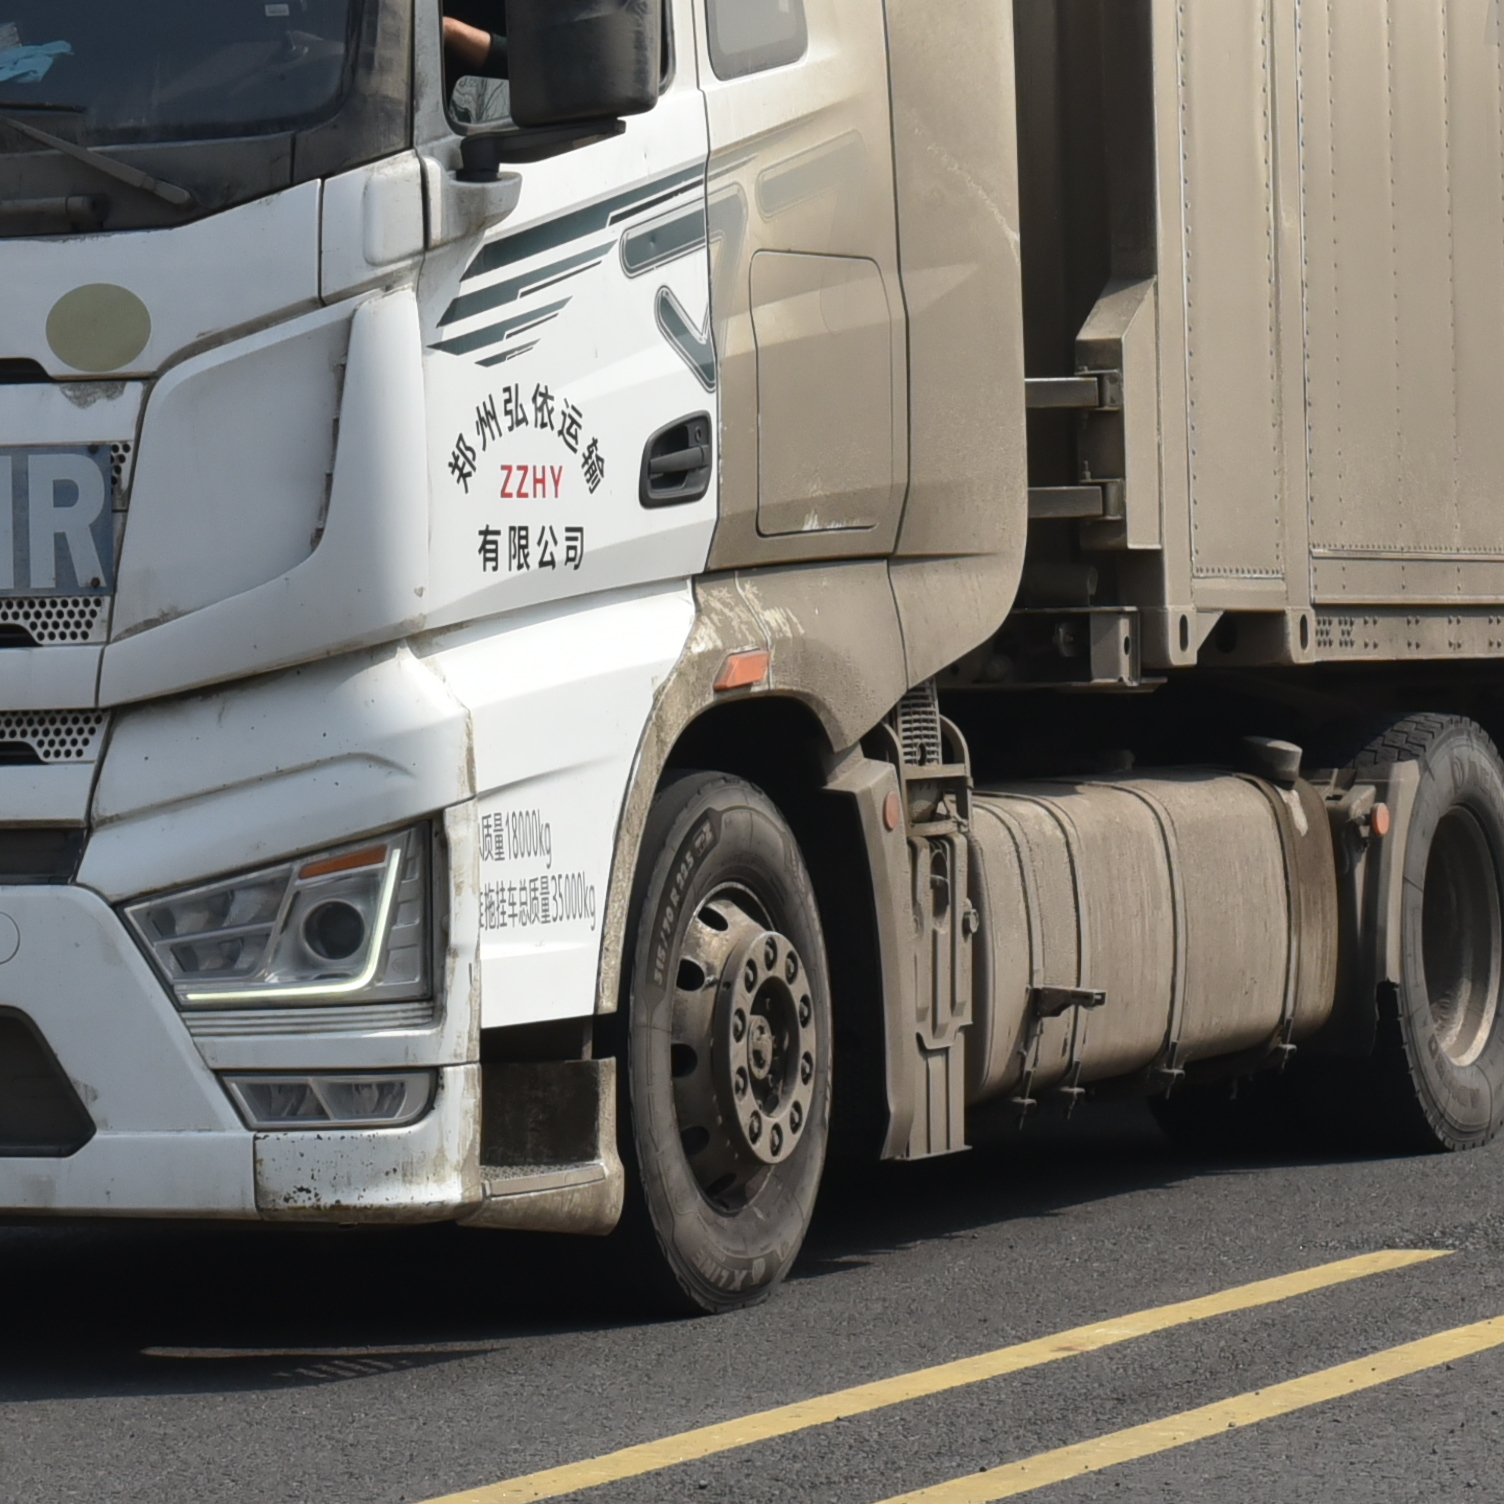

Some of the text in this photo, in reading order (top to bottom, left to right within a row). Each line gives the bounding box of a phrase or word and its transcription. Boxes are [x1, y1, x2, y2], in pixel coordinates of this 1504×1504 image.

[448, 382, 605, 495] 郑州弘依运输
[500, 464, 564, 499] ZZHY
[477, 523, 584, 572] 有限公司
[478, 809, 552, 870] 质量18000kg
